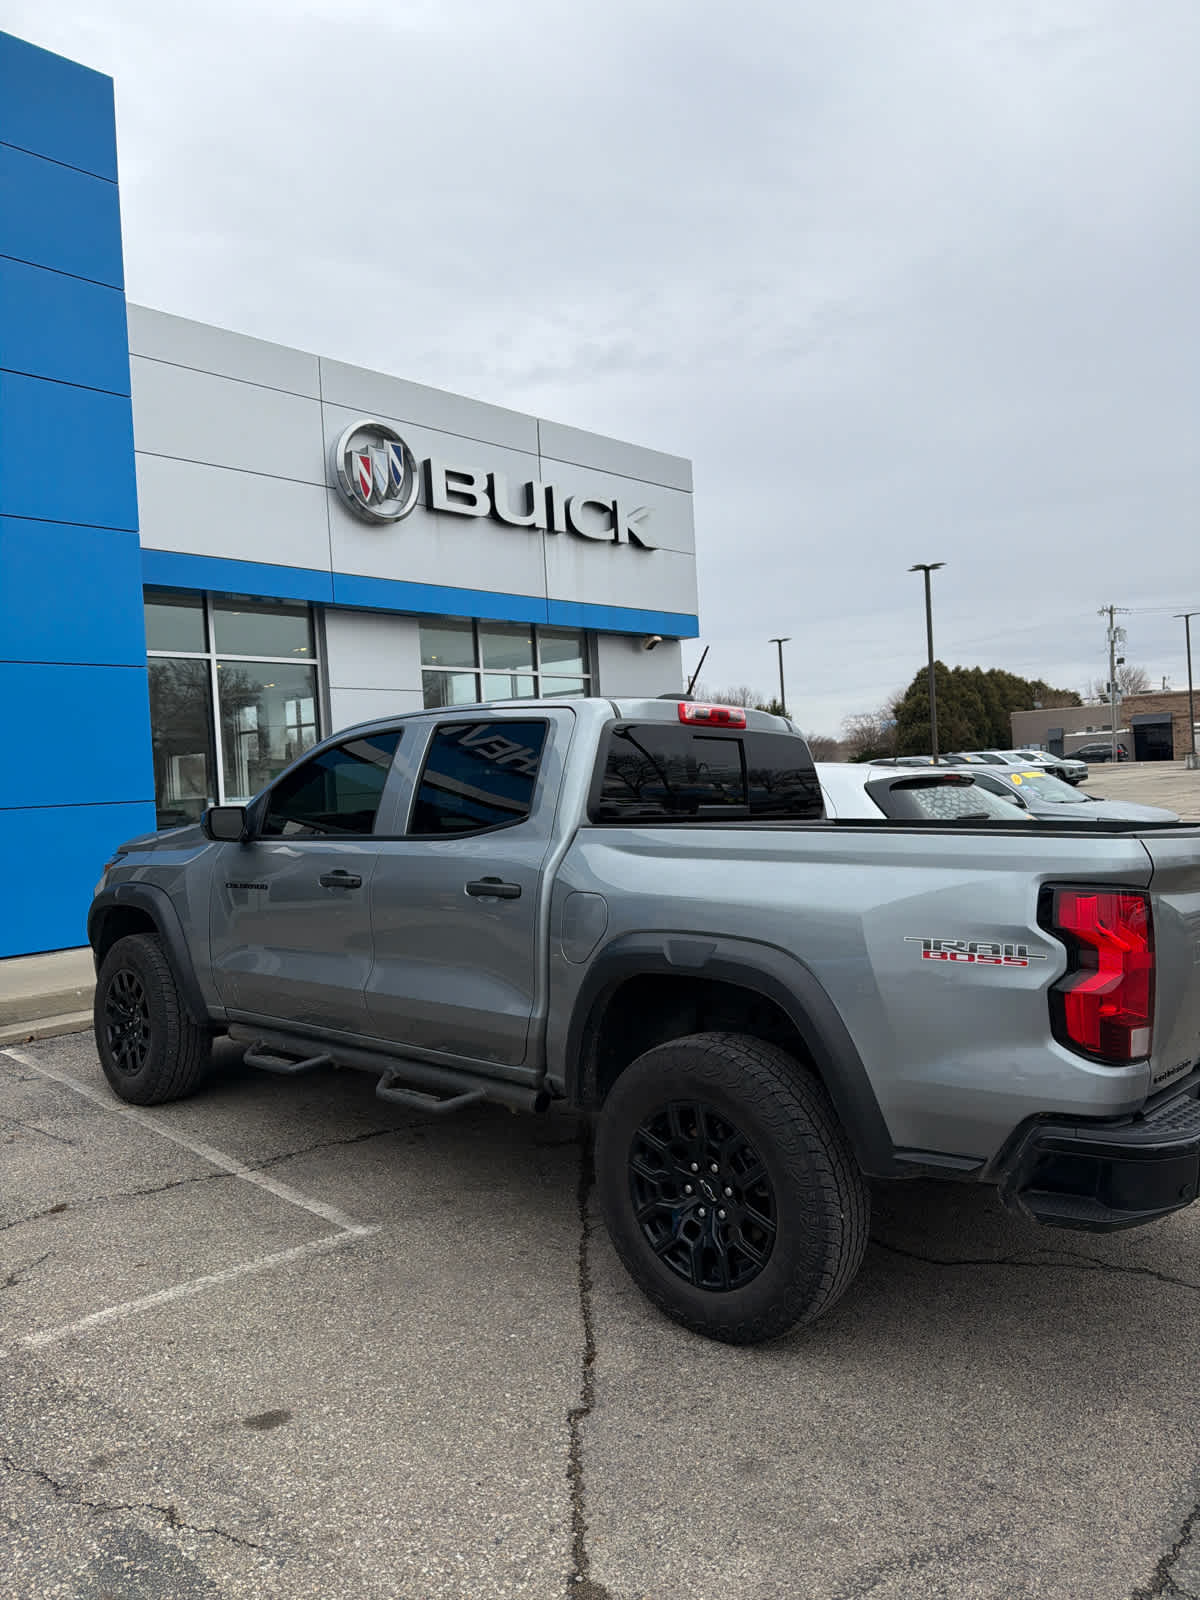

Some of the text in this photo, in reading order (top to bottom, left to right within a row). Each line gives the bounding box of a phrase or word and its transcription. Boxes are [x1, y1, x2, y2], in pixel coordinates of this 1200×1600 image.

[421, 457, 657, 550] BUICK
[904, 937, 1047, 960] TRAIL
[922, 950, 1028, 967] BOSS
